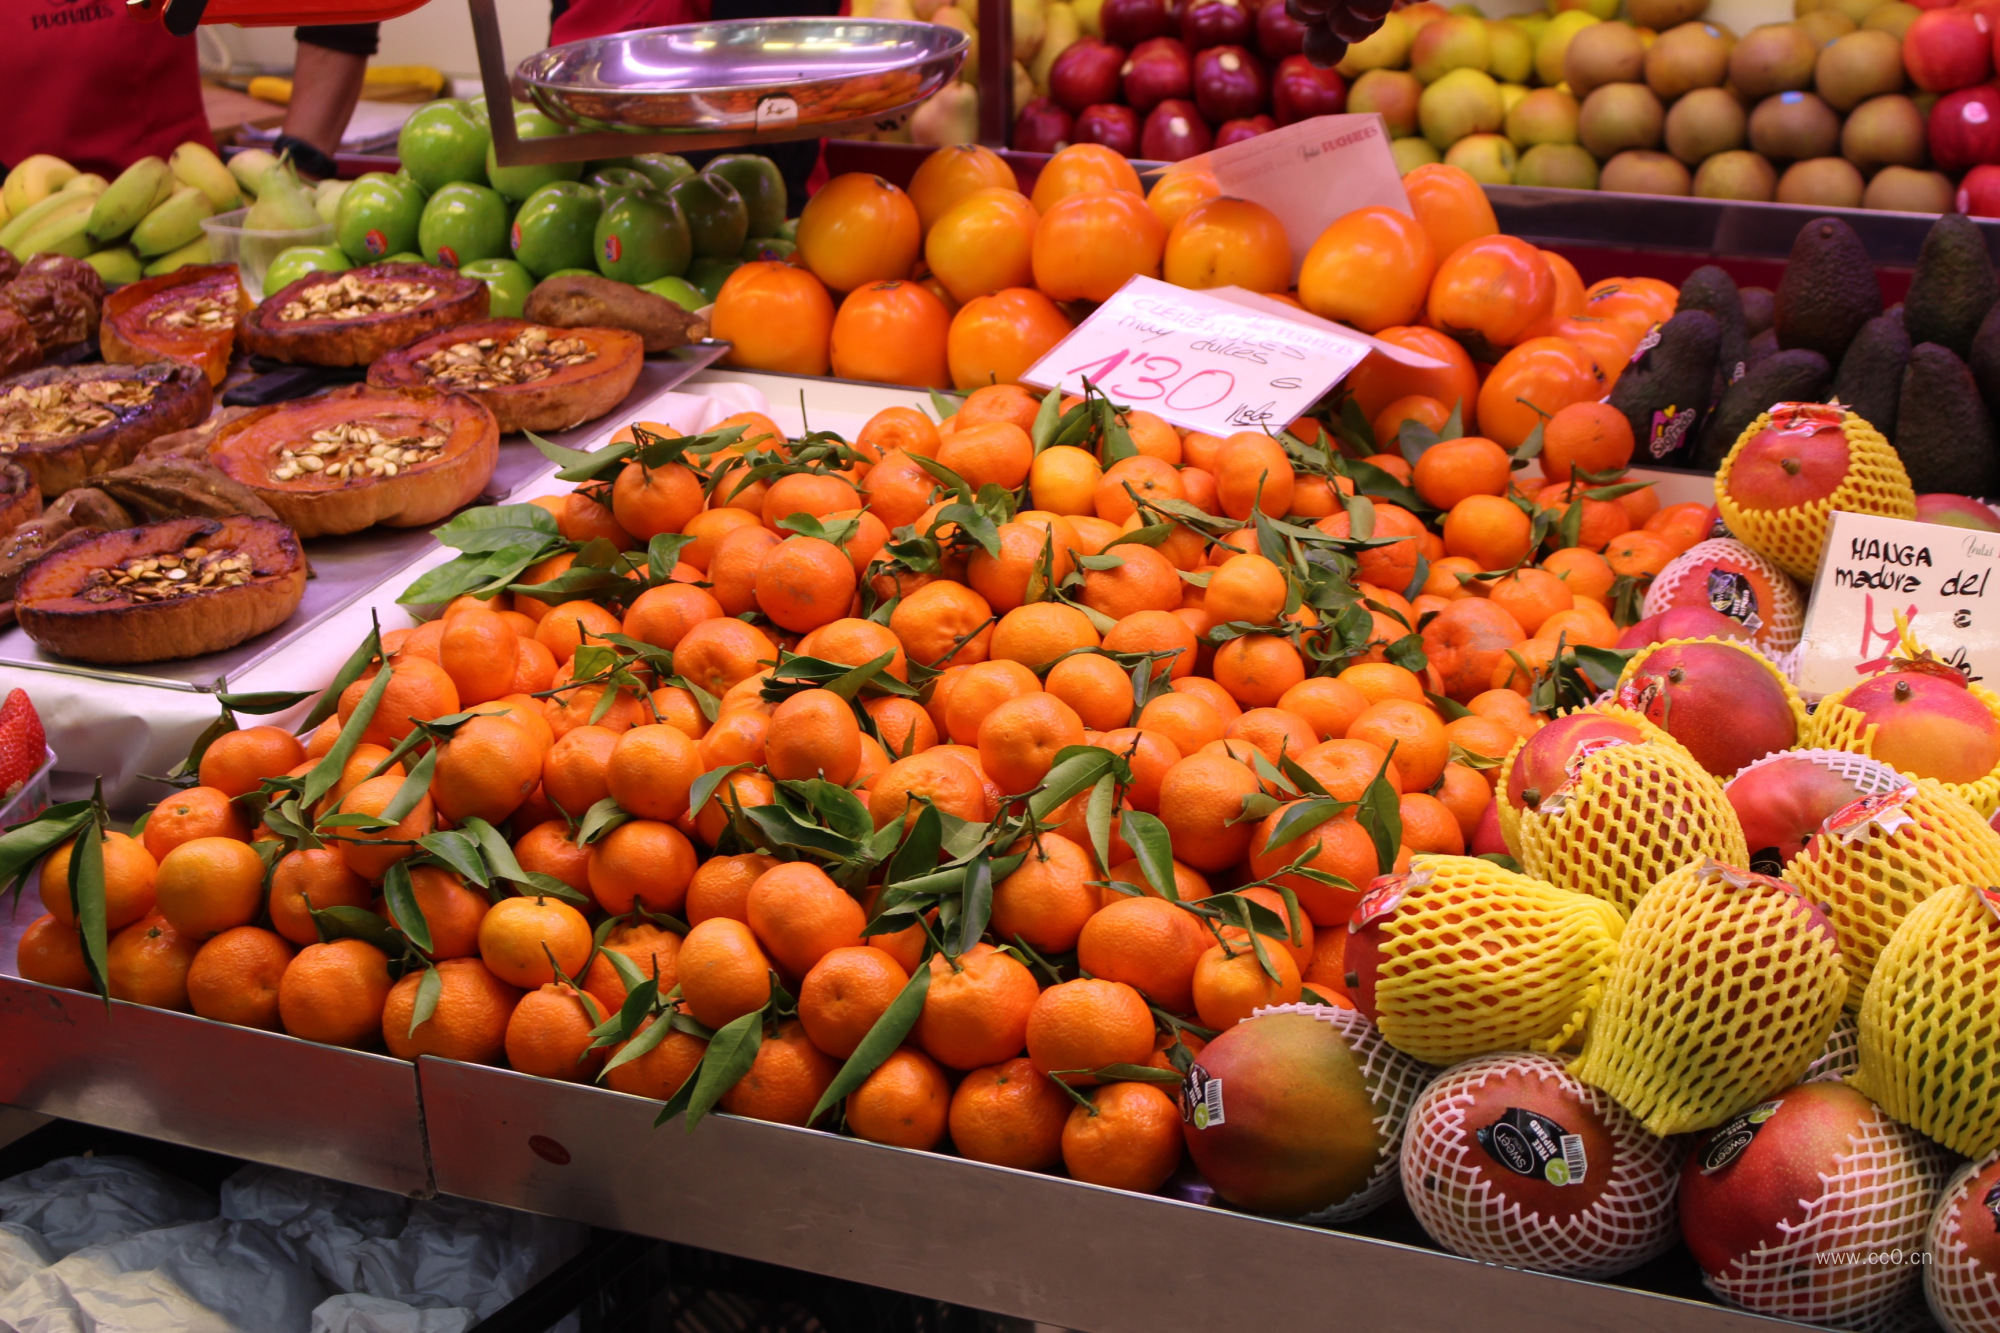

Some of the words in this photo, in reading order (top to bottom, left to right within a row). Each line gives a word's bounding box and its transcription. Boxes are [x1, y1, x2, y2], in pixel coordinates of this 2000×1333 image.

[1118, 314, 1176, 344] muy
[1189, 338, 1268, 365] dulces
[1939, 567, 1992, 598] del
[1529, 1119, 1558, 1155] RIPENED
[1531, 1138, 1550, 1162] TREE
